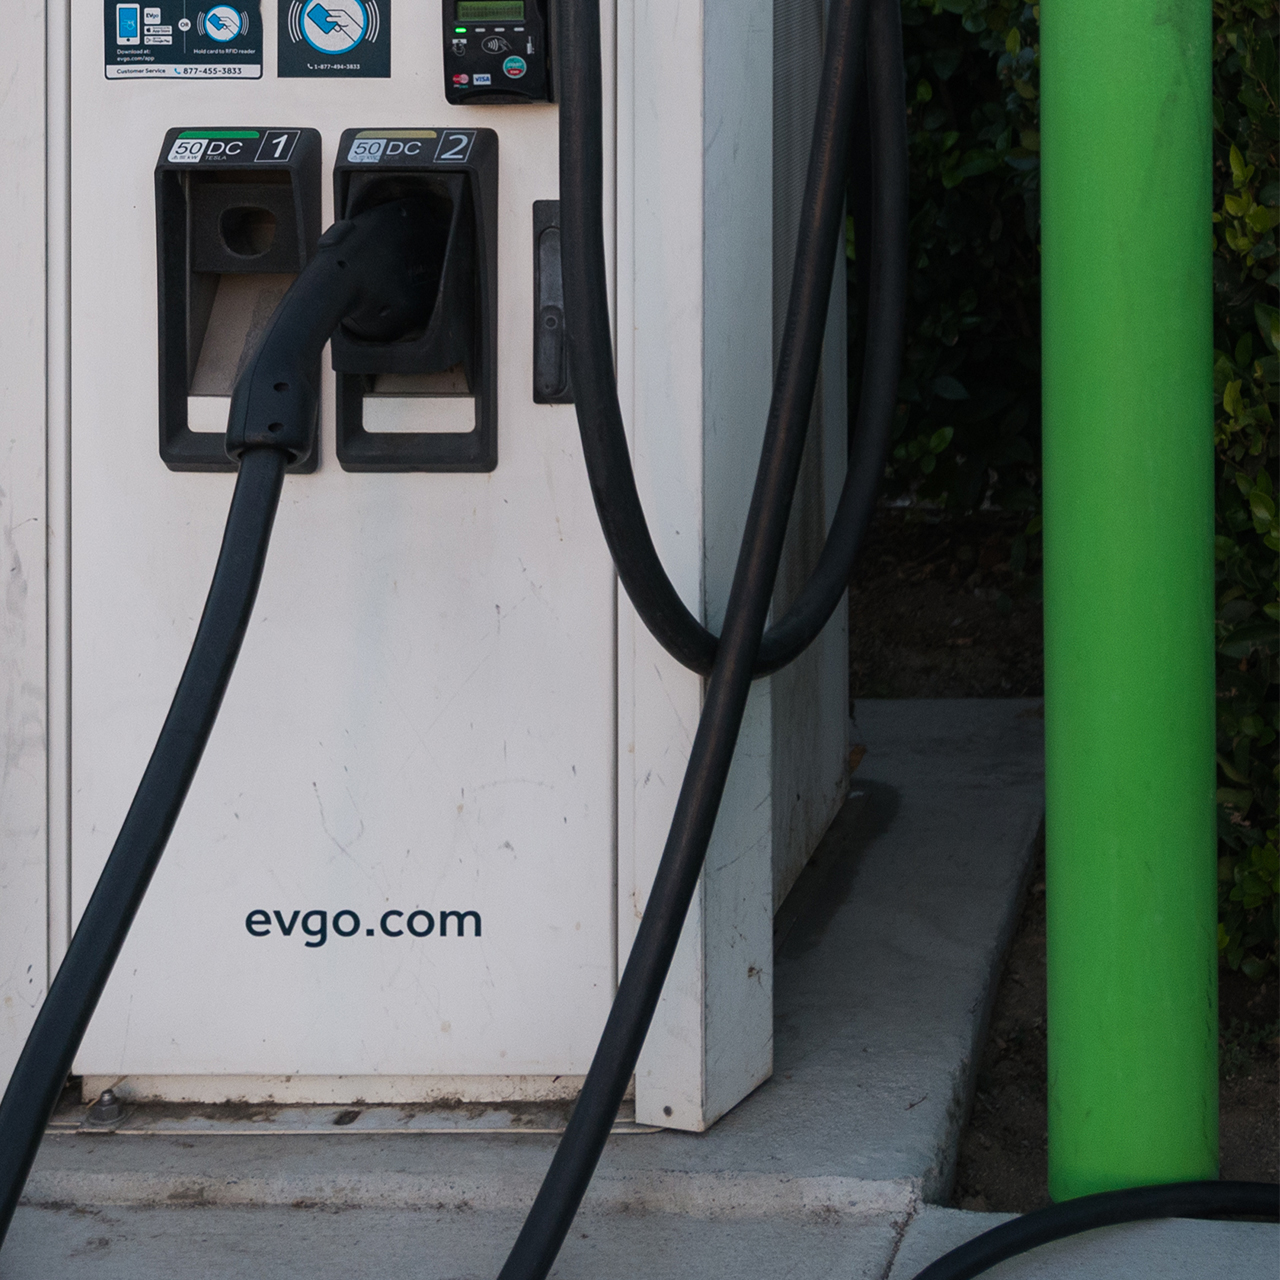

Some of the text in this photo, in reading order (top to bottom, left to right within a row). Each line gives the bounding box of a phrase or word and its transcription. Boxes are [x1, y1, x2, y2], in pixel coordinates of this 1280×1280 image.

[183, 67, 242, 75] 877-455-3833
[175, 134, 288, 158] 50 DC 1
[354, 134, 468, 159] 50 DC 2
[245, 909, 482, 948] evgo.com
